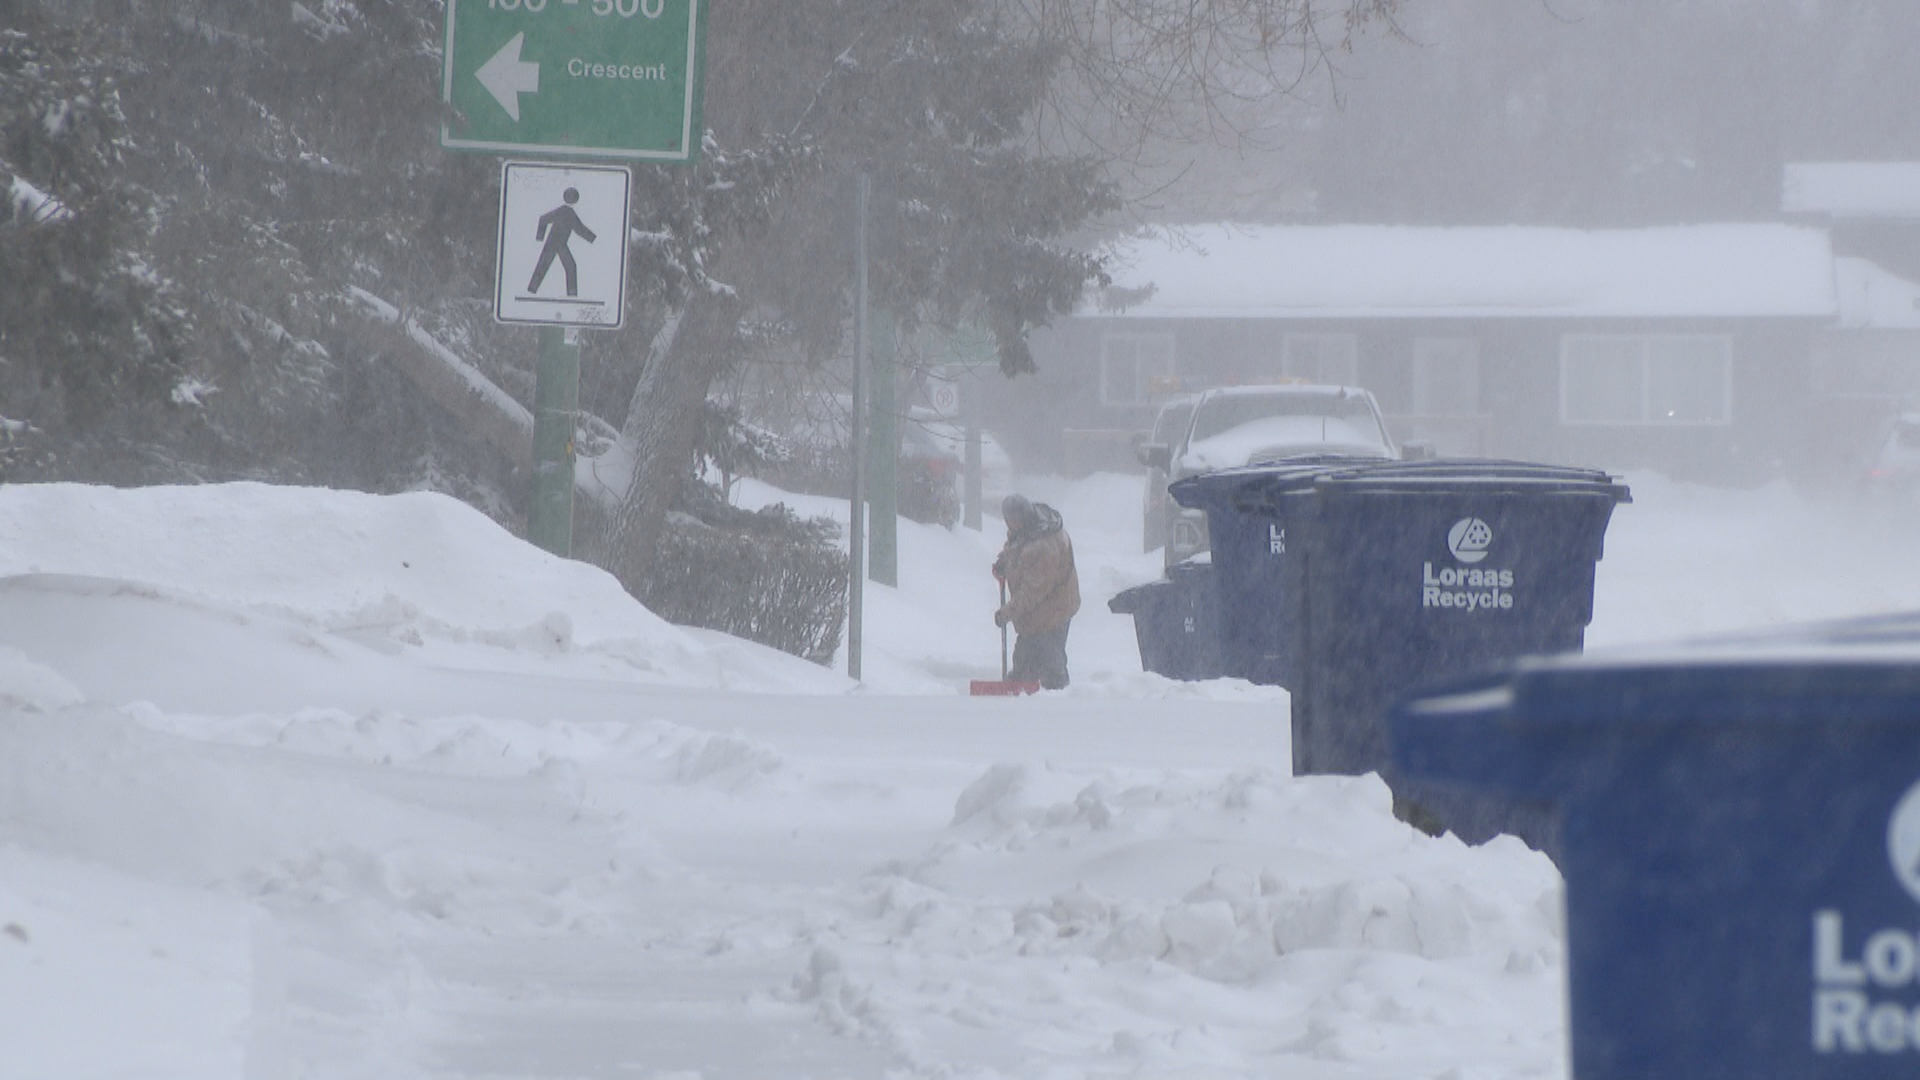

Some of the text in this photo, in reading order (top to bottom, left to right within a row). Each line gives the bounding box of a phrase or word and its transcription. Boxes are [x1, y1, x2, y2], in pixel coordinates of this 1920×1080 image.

[567, 58, 666, 80] Crescent
[1423, 560, 1514, 588] Loraas
[1422, 586, 1514, 612] Recycle
[1813, 909, 1920, 987] Lo
